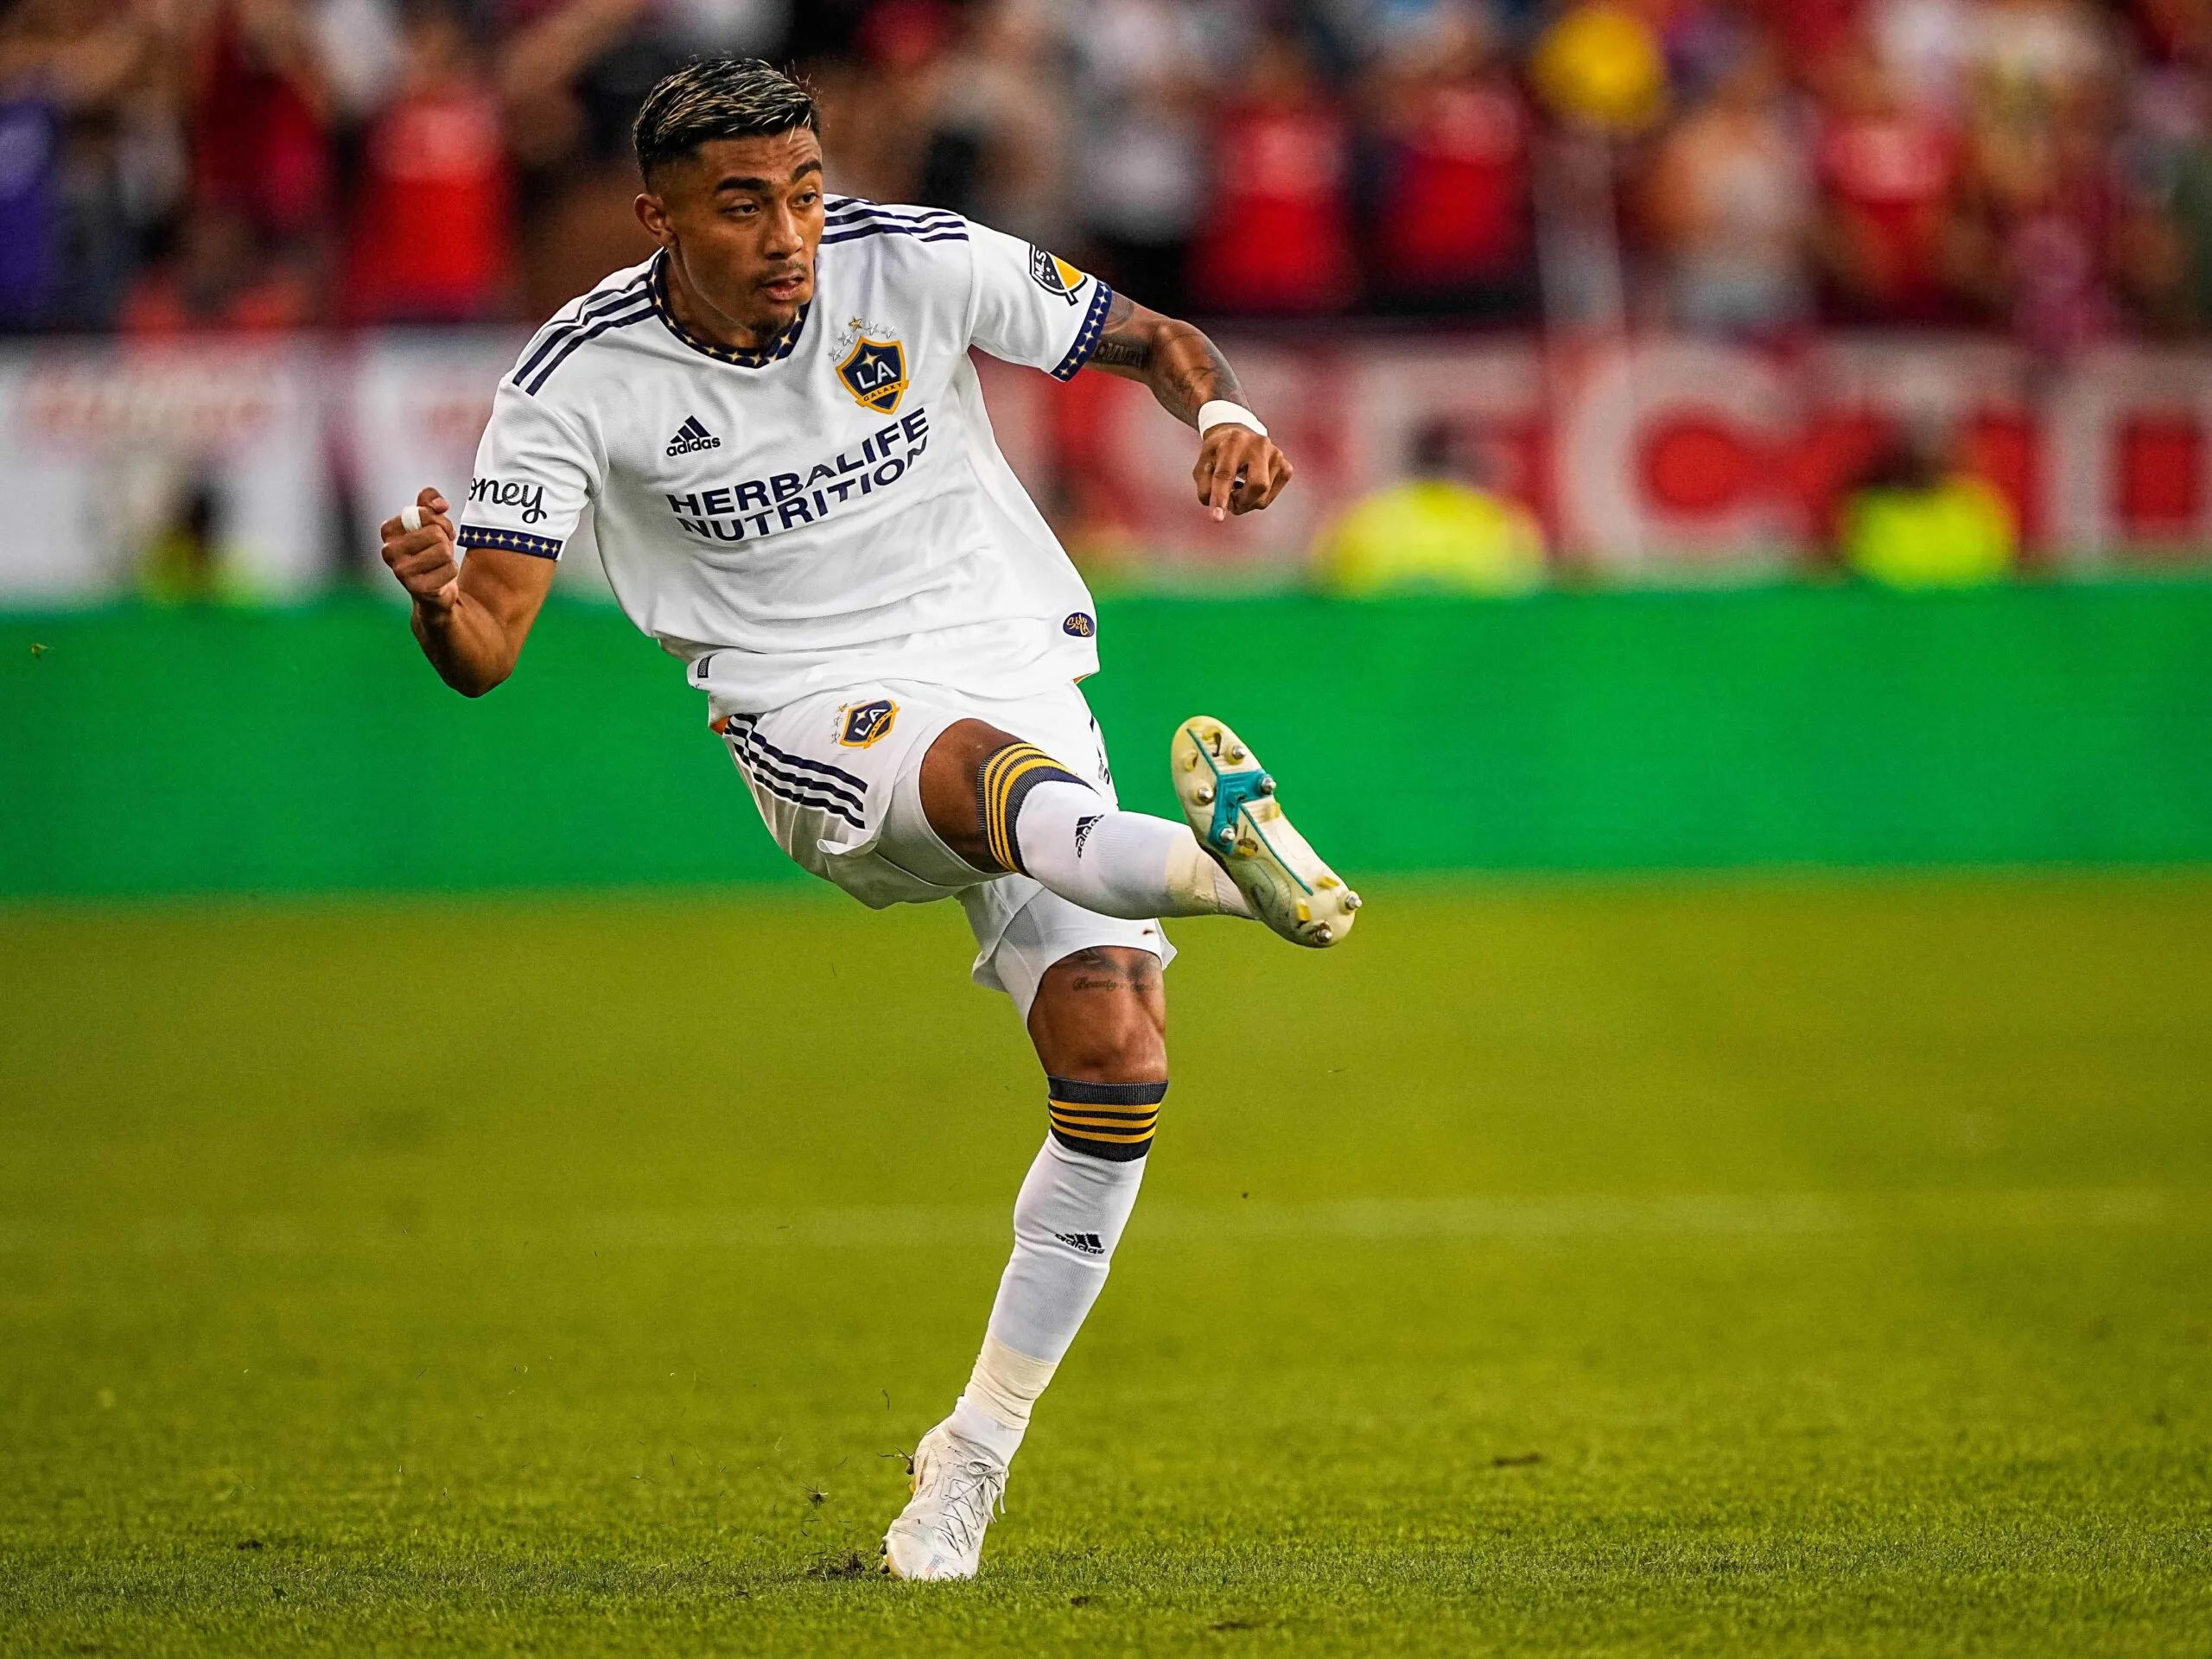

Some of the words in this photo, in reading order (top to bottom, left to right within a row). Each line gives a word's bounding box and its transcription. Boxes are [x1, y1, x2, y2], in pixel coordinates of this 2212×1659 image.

[1035, 249, 1046, 279] MLS
[856, 361, 897, 389] LA
[864, 382, 902, 402] GALAXY
[666, 435, 721, 457] adidas
[666, 407, 930, 503] HERBALIFE
[677, 435, 928, 542] NUTRITION
[854, 709, 888, 736] LA
[1054, 1233, 1105, 1254] adidas
